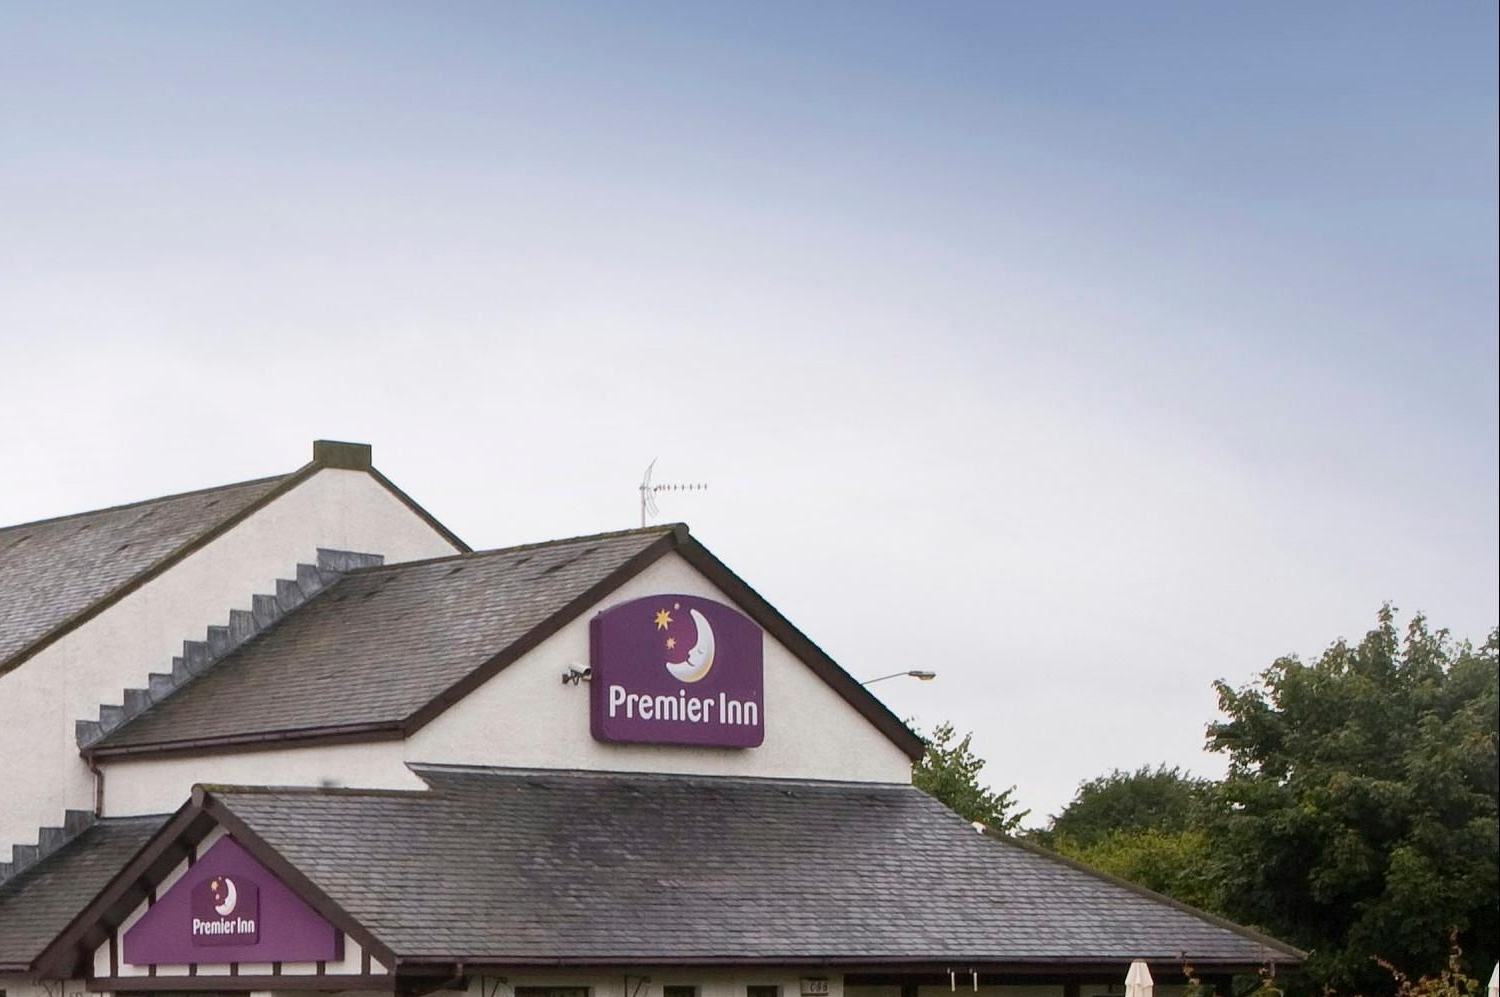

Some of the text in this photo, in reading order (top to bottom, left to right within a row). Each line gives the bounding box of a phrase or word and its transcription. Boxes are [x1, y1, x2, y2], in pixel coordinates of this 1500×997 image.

[609, 685, 758, 726] Premier Inn
[192, 917, 255, 935] Premier Inn
